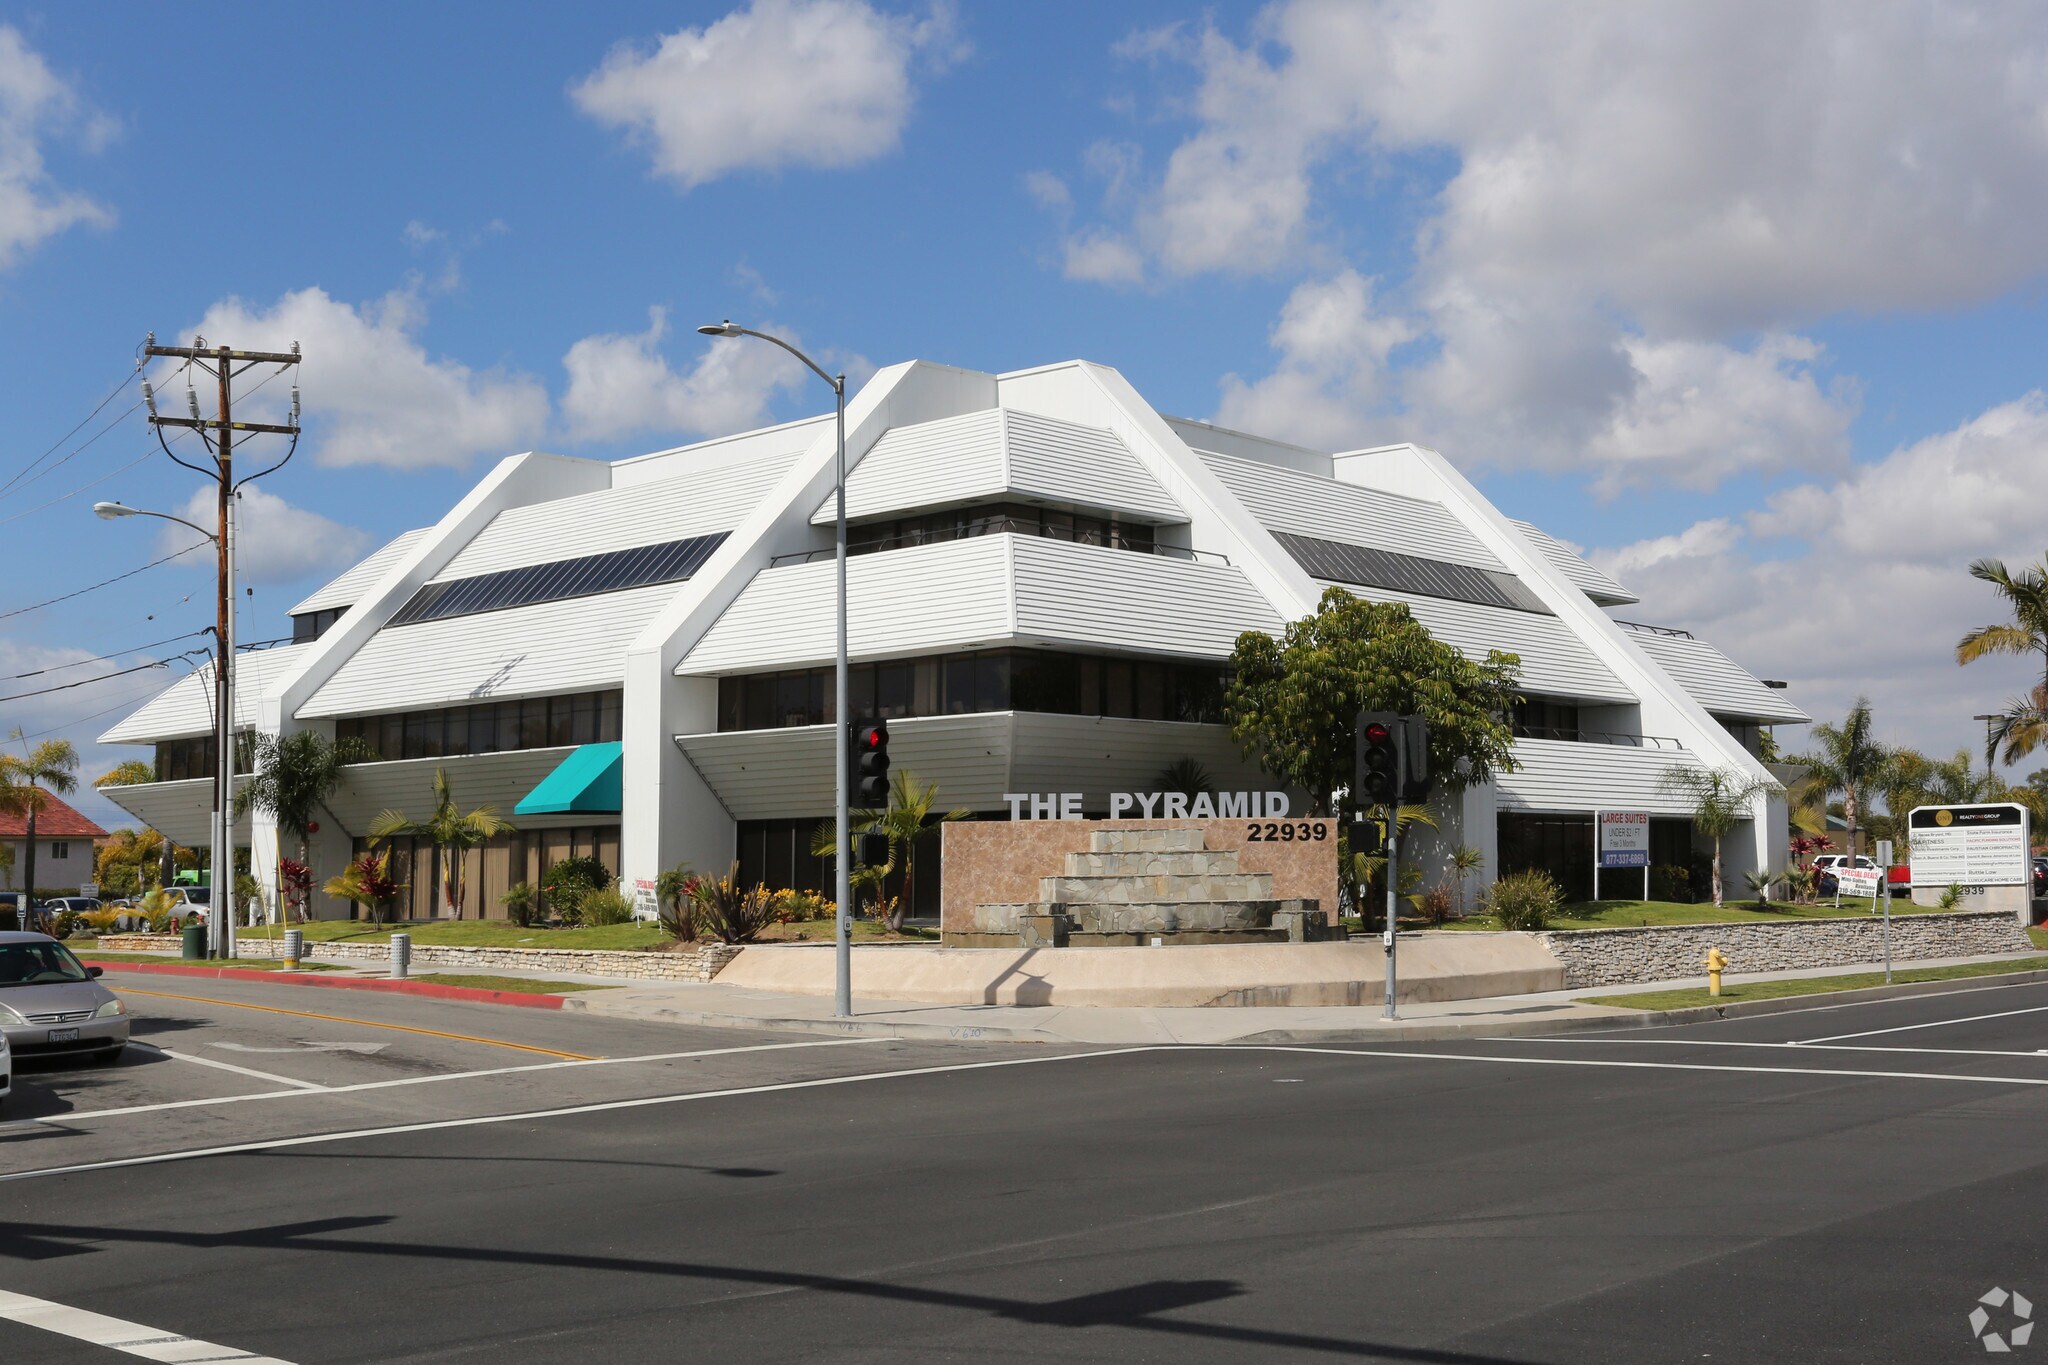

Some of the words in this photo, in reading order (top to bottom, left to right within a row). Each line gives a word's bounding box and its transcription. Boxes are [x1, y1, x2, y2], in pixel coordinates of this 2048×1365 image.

[1003, 793, 1083, 821] THE
[1110, 791, 1290, 820] PYRAMID
[1602, 813, 1624, 824] LARGE
[1624, 813, 1647, 824] SUITES
[1247, 823, 1327, 842] 22939
[1608, 828, 1626, 837] UNDER
[1610, 839, 1620, 848] Free
[1841, 868, 1862, 878] SPECIAL
[1863, 871, 1878, 880] DEALS
